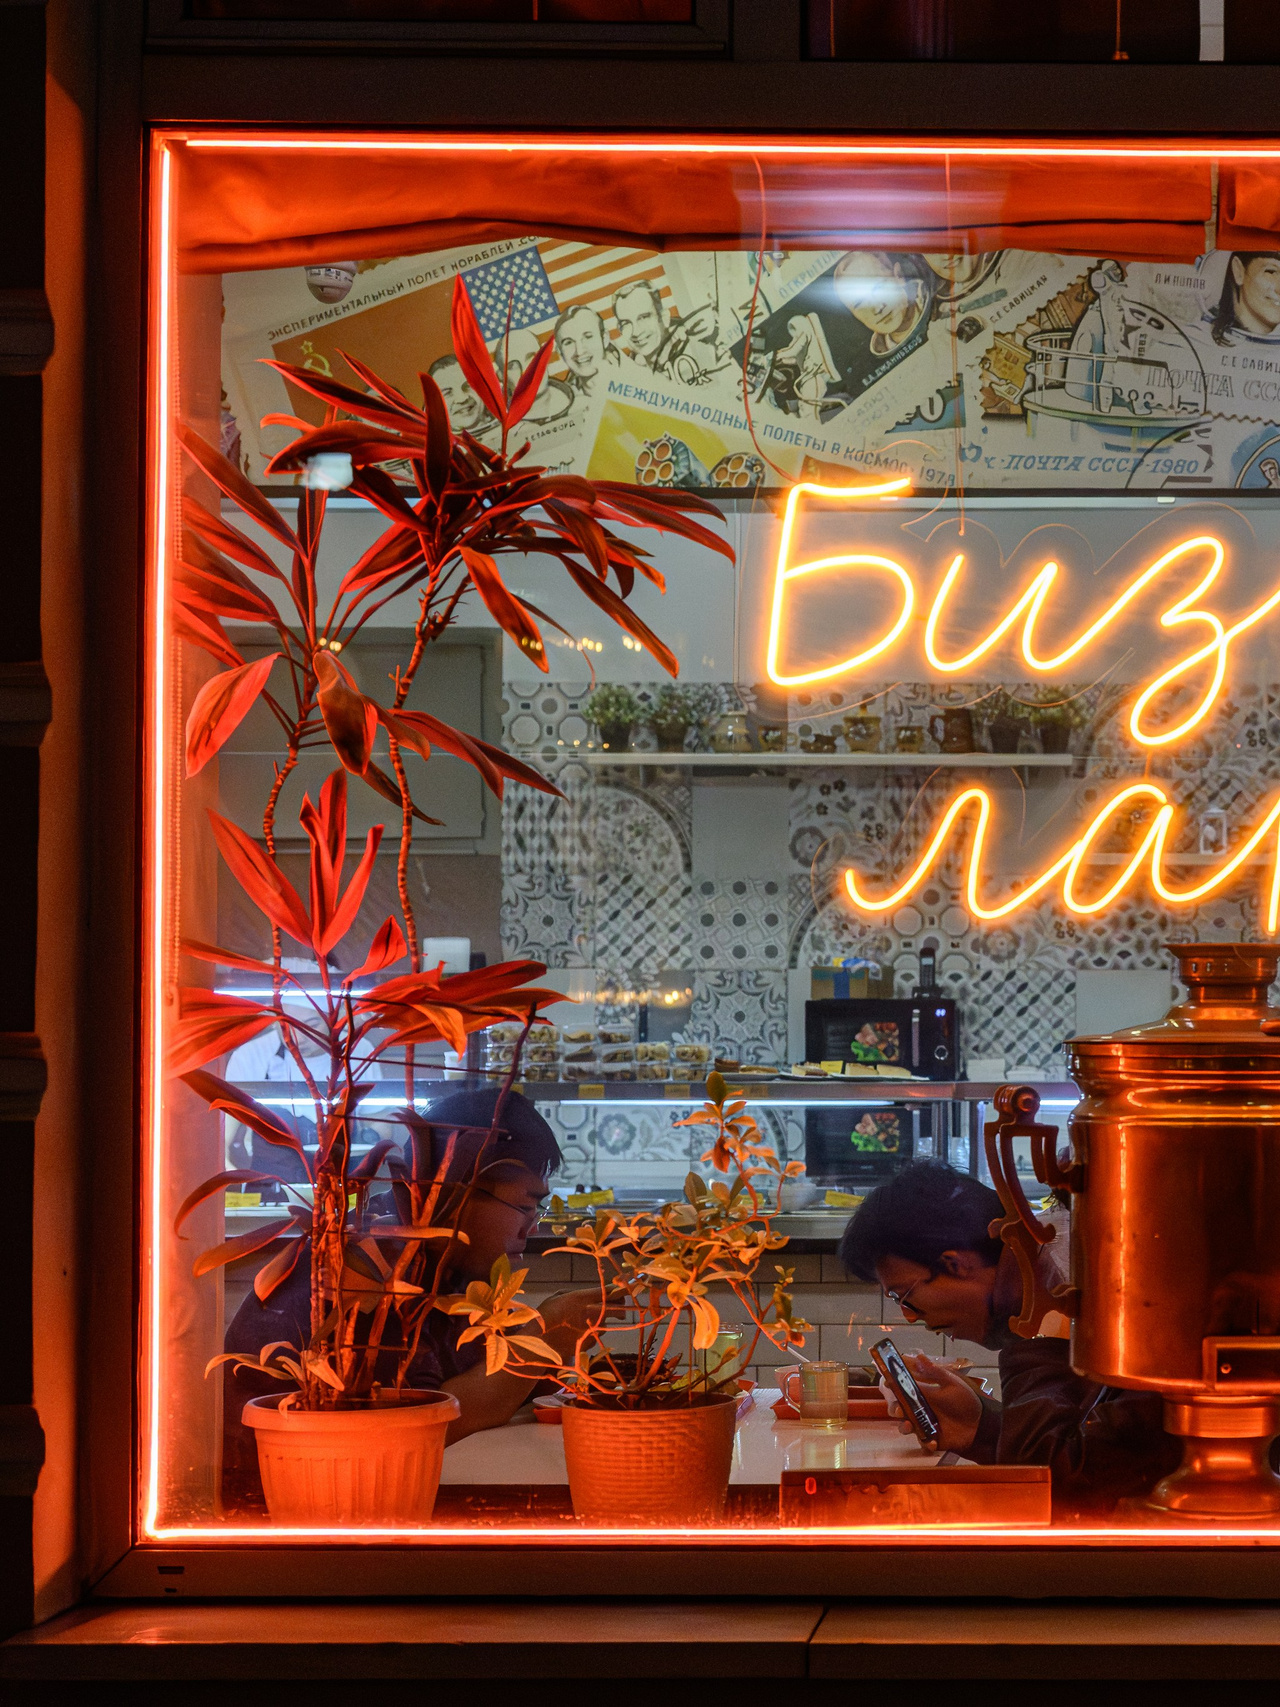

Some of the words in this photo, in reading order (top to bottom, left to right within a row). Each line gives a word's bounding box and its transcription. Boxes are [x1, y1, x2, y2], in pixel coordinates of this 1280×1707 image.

[407, 266, 446, 288] ПОЛЕТ
[763, 424, 827, 453] ПОЛЕТЫ
[1002, 453, 1085, 473] ПОЧТА
[1087, 456, 1145, 473] СССР
[1149, 458, 1200, 475] 1980
